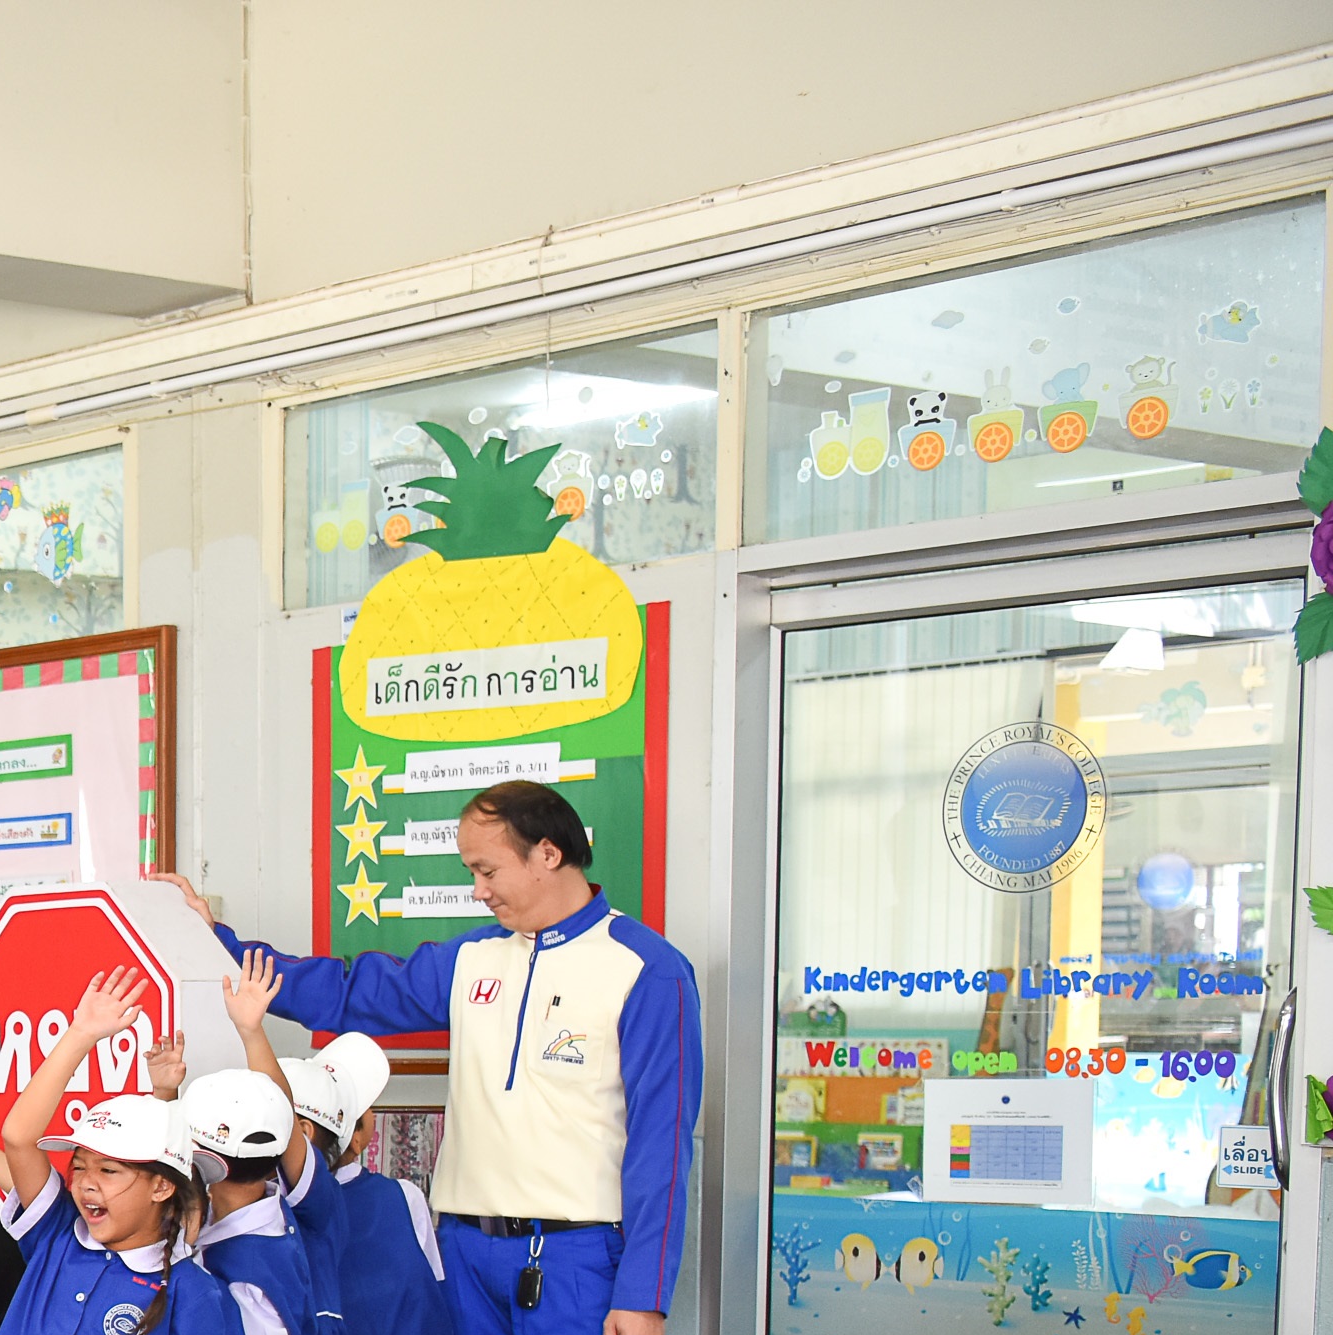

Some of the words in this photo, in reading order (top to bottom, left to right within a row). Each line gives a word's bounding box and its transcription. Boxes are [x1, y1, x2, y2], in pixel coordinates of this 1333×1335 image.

[374, 662, 478, 705] เด็กดีรัก
[485, 654, 599, 697] การอ่าน
[1003, 725, 1067, 747] ROYAL'S
[528, 762, 548, 774] 3/11
[954, 735, 1001, 786] PRINCE
[1067, 742, 1102, 816] COLLEGE
[948, 789, 961, 825] THE
[963, 853, 1018, 888] CHIANG
[1023, 870, 1053, 889] MAI
[1056, 850, 1083, 875] 1906
[979, 844, 1041, 870] FOUNDED
[1043, 840, 1066, 862] 1887
[804, 966, 1009, 998] Kindergarten
[1020, 964, 1155, 1000] Library
[1177, 966, 1265, 998] Room
[804, 1041, 933, 1070] Welcome
[952, 1048, 1019, 1076] open
[1044, 1046, 1127, 1079] 08.30
[1159, 1050, 1237, 1082] 16.00
[1233, 1166, 1264, 1175] SLIDE
